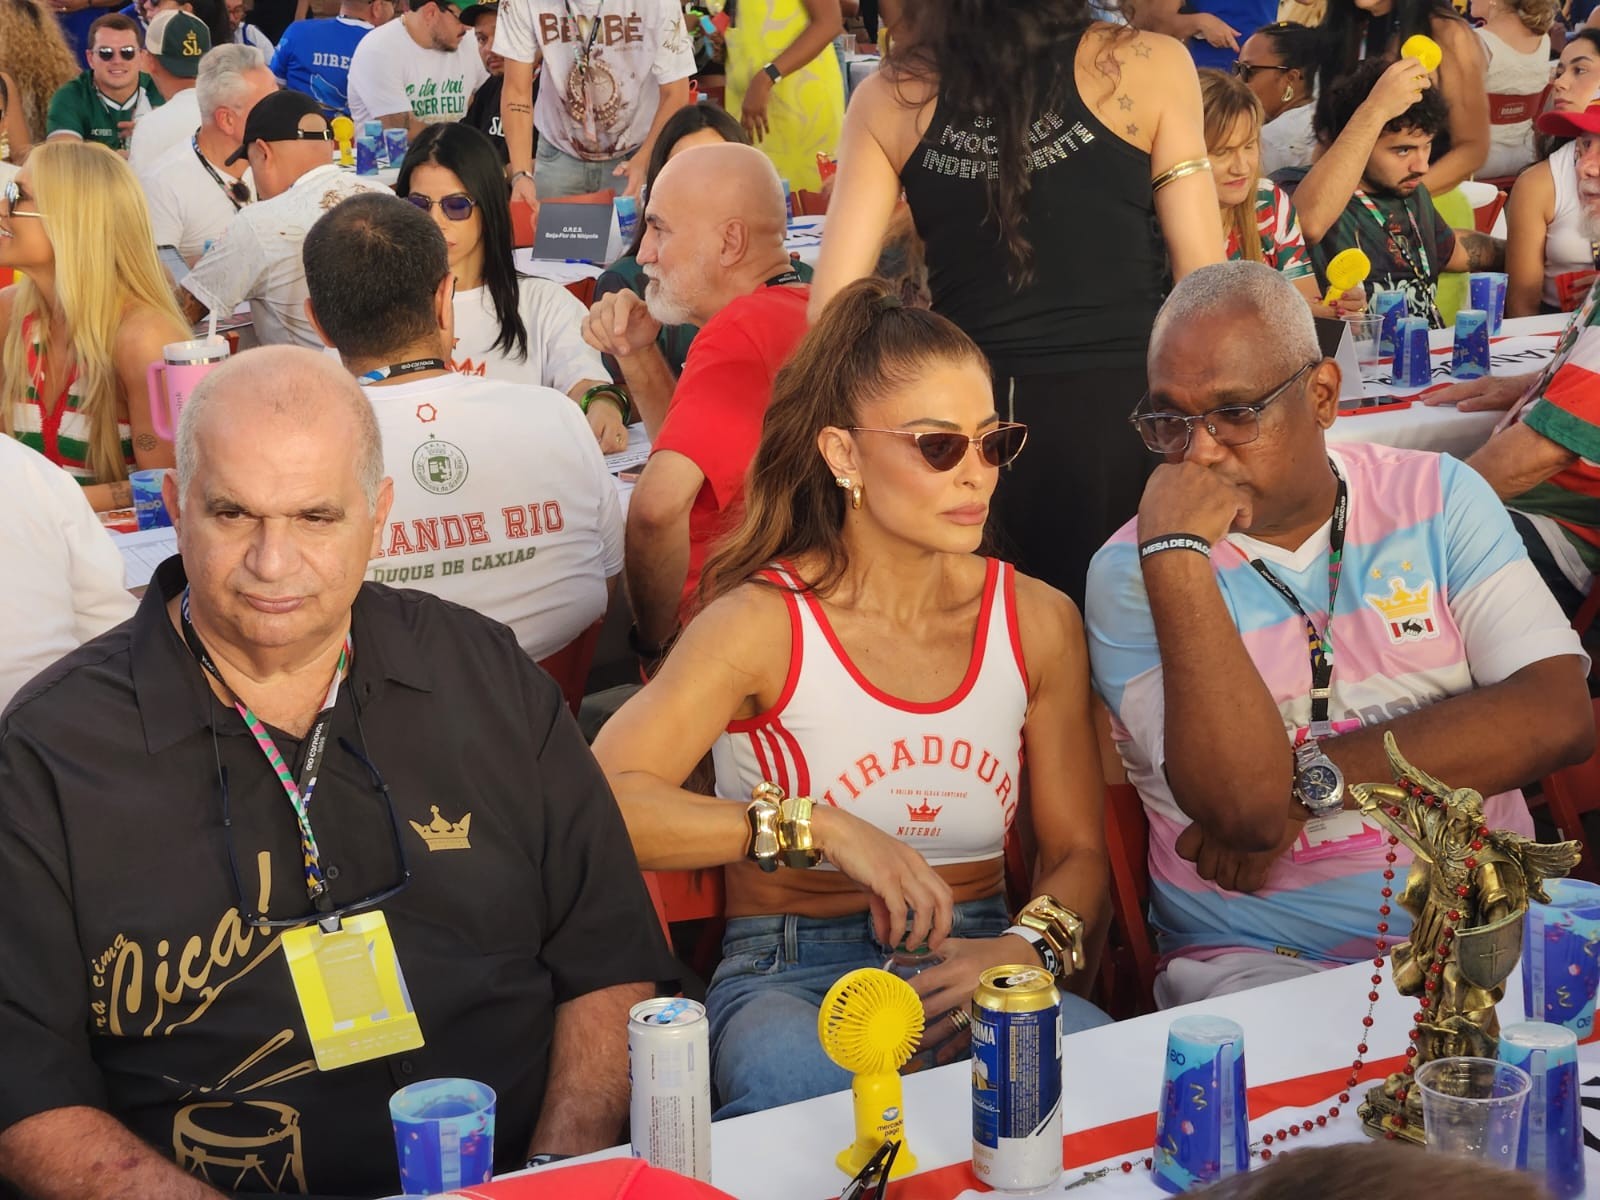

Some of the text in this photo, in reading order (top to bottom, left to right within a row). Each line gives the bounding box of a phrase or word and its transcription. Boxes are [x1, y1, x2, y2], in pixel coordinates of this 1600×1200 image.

[312, 52, 351, 69] DIRE
[376, 500, 564, 558] ANDE RIO
[1169, 539, 1185, 548] DE
[375, 546, 537, 584] DUQUE DE CAXIAS
